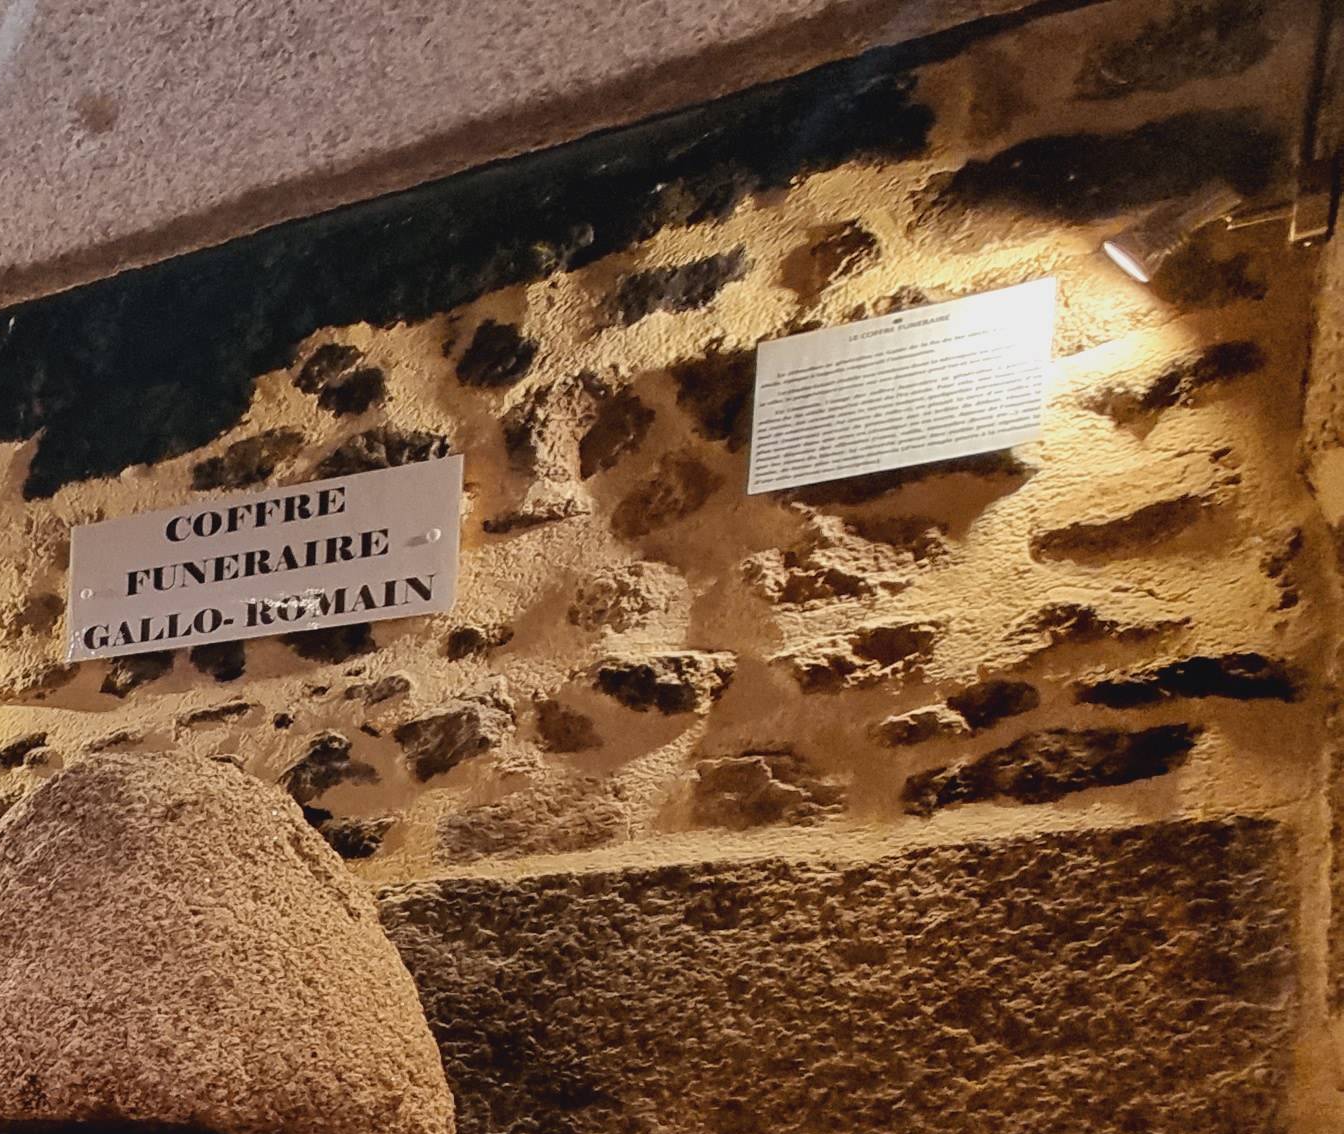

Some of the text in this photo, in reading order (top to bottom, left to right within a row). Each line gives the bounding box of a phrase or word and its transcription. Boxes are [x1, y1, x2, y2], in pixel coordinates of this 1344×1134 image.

[165, 486, 347, 543] COFFRE
[125, 528, 390, 597] FUNERAIRE
[245, 574, 437, 627] ROMAIN
